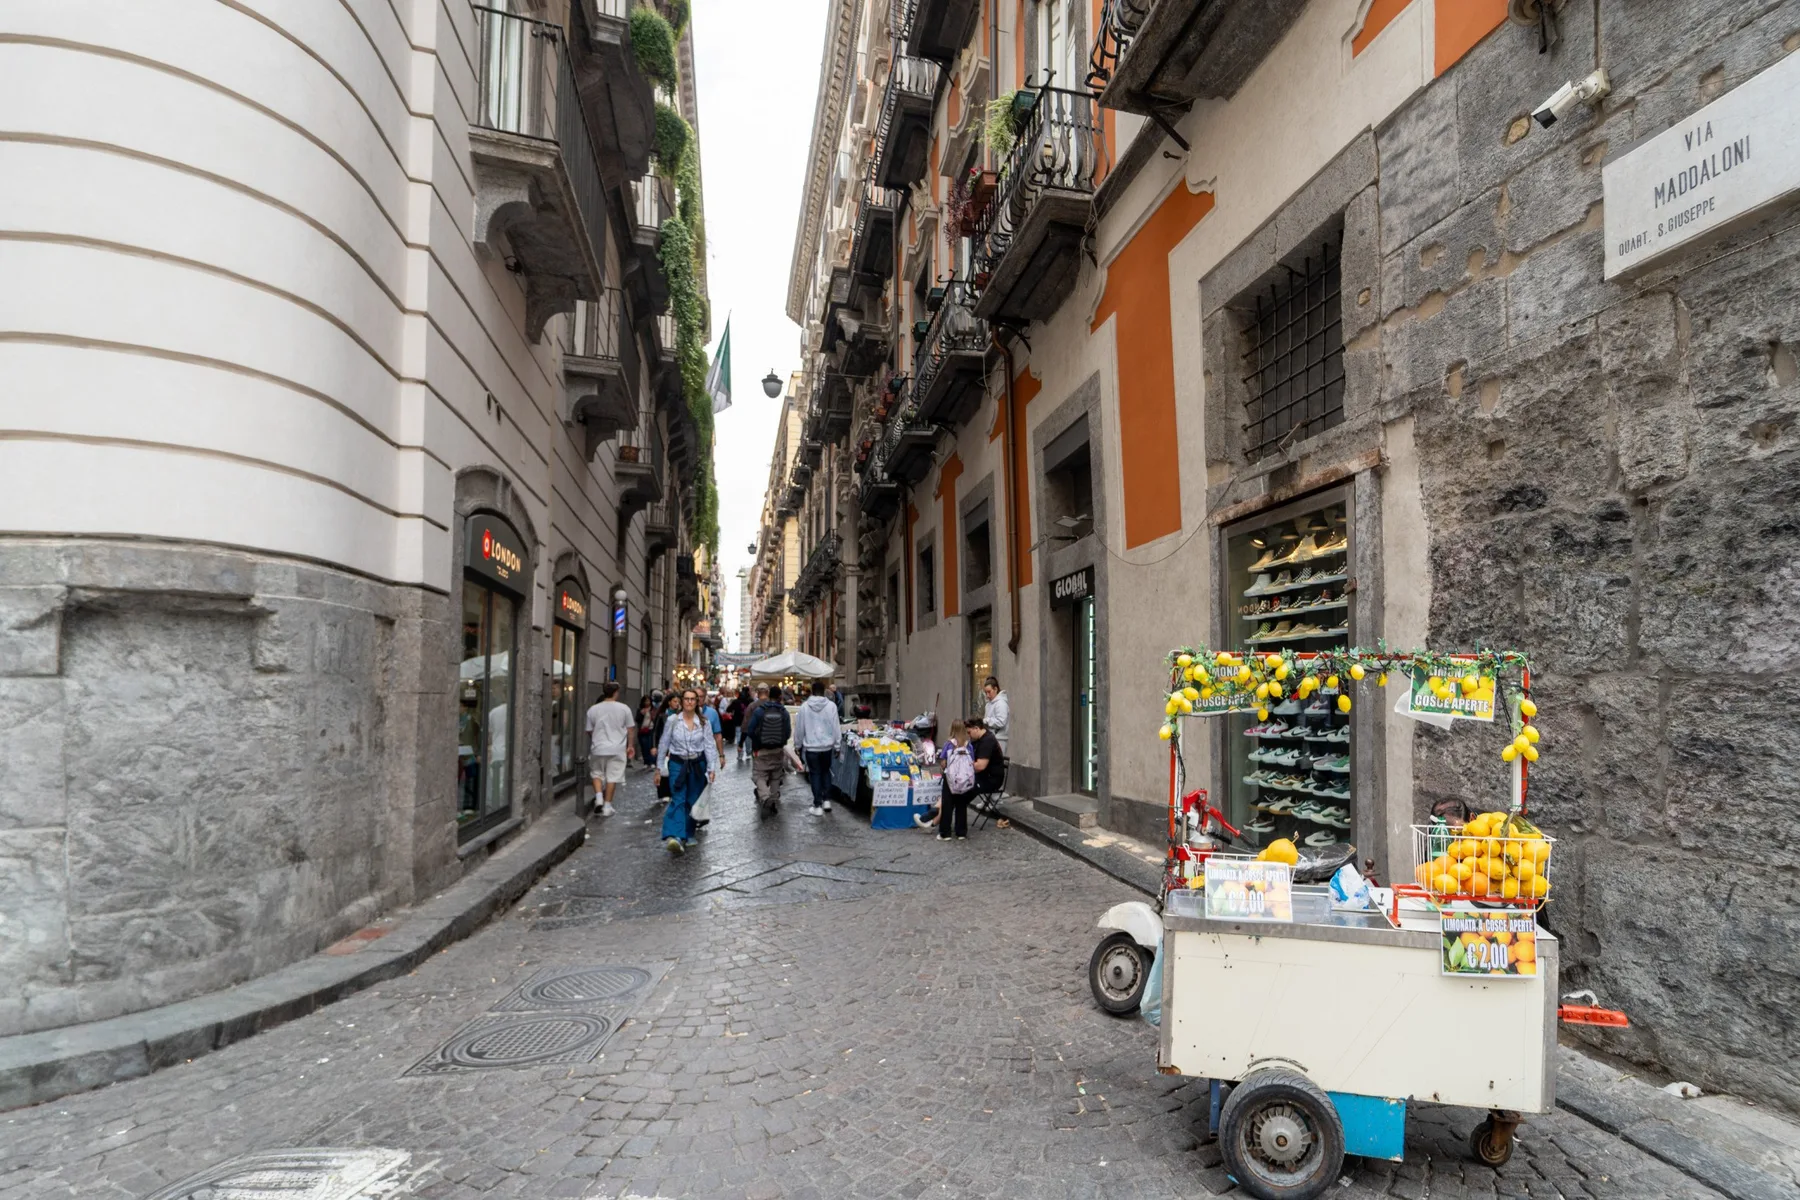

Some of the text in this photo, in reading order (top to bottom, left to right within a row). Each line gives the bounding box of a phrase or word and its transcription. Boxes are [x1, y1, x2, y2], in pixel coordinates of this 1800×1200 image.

[1685, 121, 1713, 151] VIA
[1654, 135, 1750, 209] MADDALONI
[1619, 196, 1715, 256] QUART. S.GIUSEPPE
[492, 539, 521, 572] LONDON
[1056, 571, 1087, 598] GLOBAL
[566, 597, 583, 614] LONDON
[1449, 681, 1457, 693] A
[1451, 697, 1489, 713] APERTE
[1444, 918, 1534, 932] LIMONATA A COSCE APERTE
[1467, 942, 1508, 971] € 2,00
